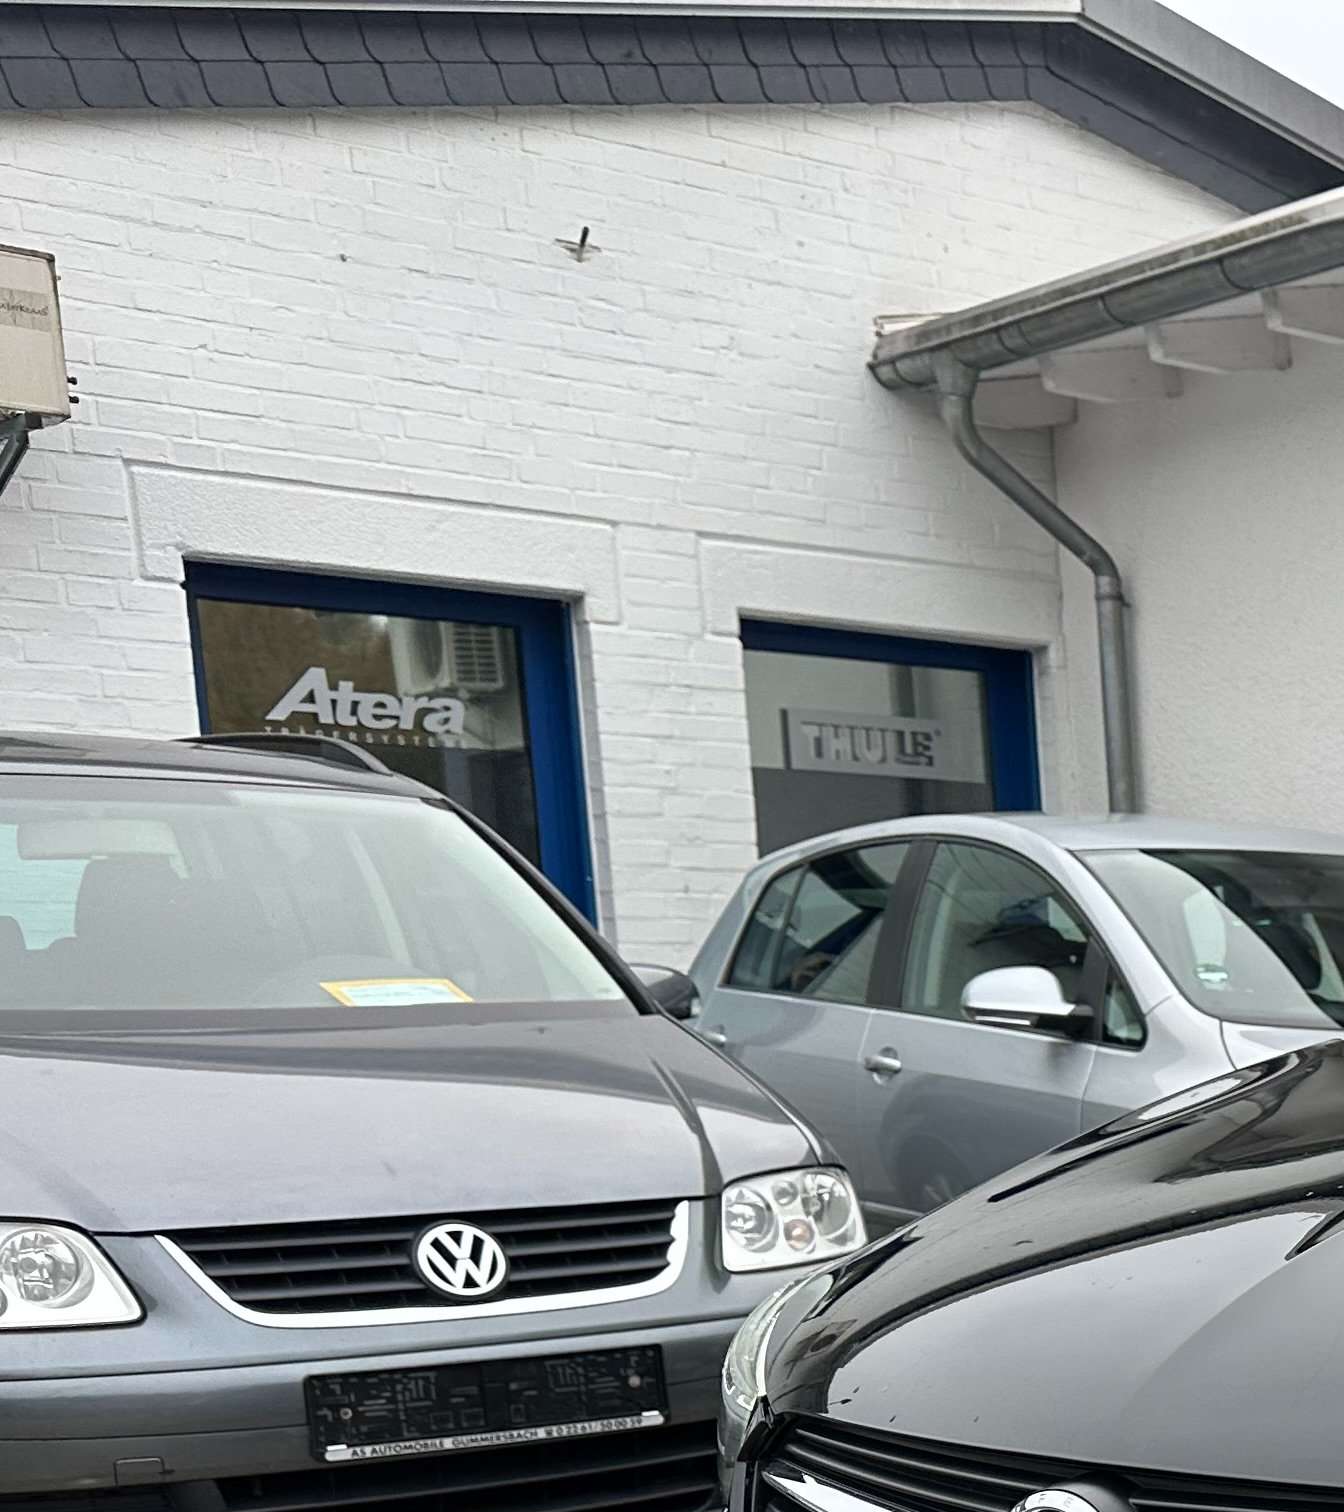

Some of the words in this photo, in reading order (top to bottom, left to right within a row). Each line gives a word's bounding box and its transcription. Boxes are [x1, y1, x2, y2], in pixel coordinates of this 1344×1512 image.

[264, 666, 465, 735] Atera
[800, 720, 935, 767] THULE
[370, 1439, 445, 1457] AUTOMOBILE
